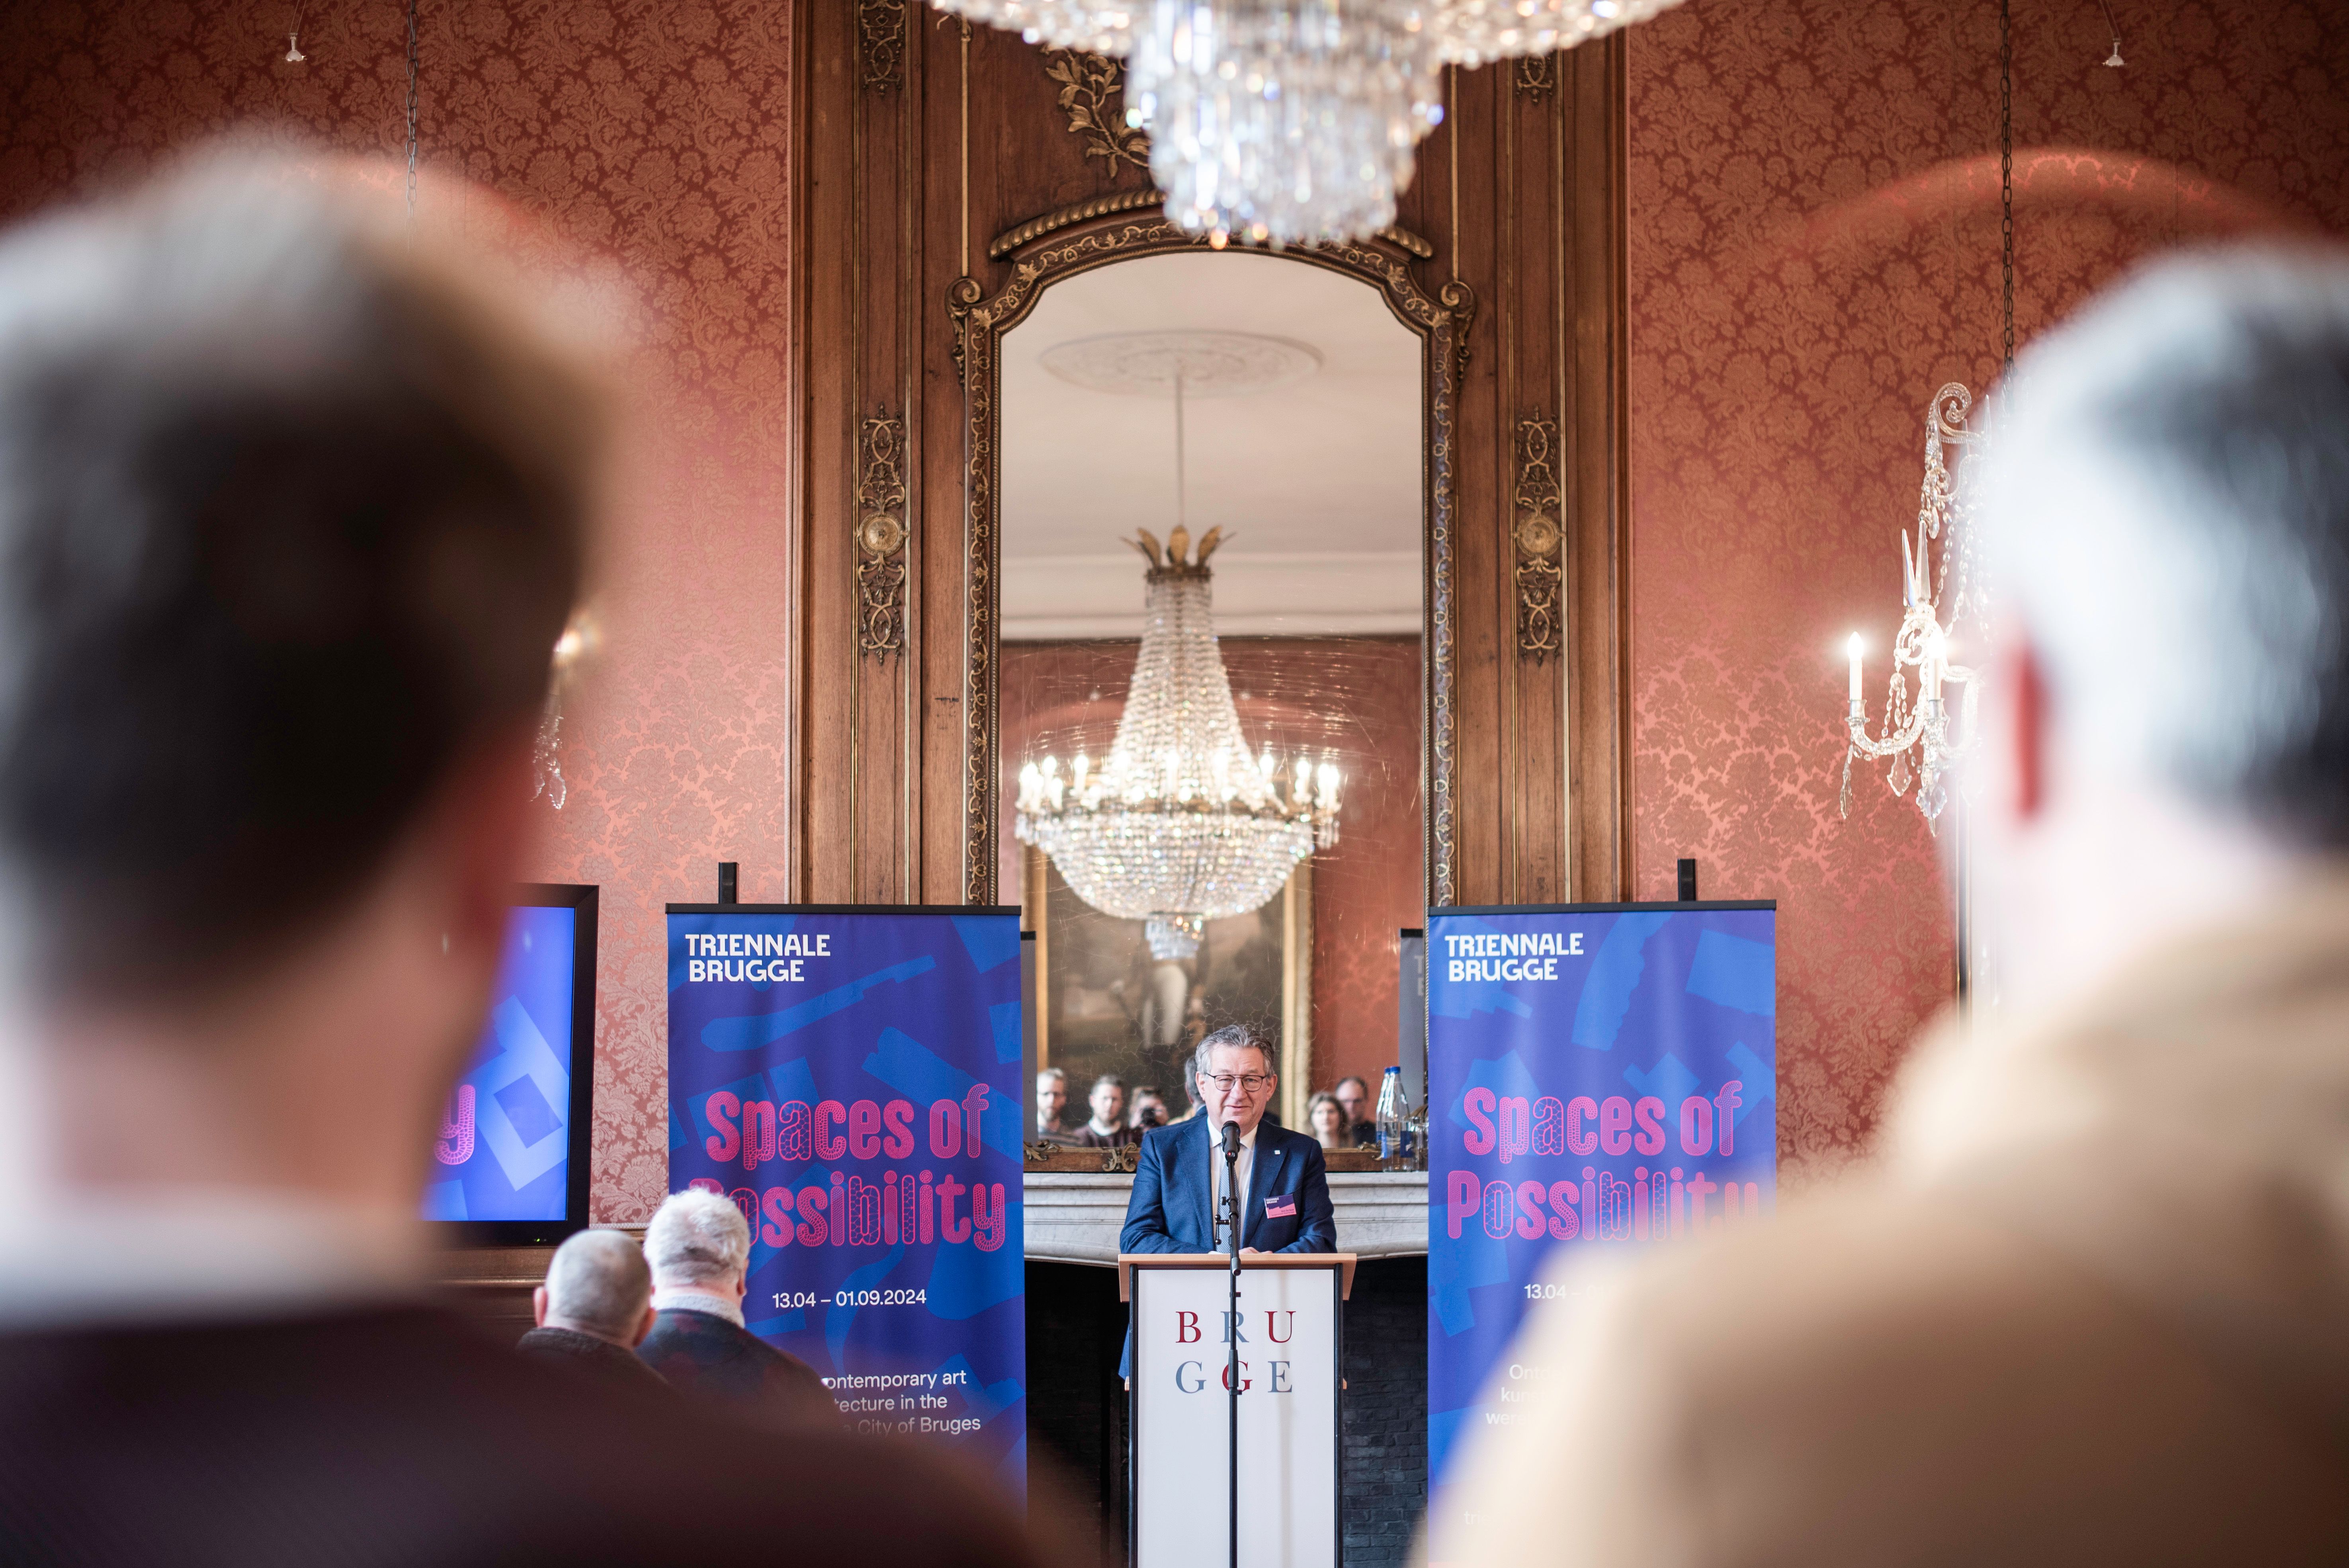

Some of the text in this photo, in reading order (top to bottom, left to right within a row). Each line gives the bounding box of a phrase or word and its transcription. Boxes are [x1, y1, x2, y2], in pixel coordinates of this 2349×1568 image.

[685, 934, 831, 957] TRIENNALE
[1444, 933, 1584, 957] TRIENNALE
[690, 959, 804, 982] BRUGGE
[1448, 958, 1558, 982] BRUGGE
[705, 1083, 990, 1171] Spaces of
[1464, 1080, 1743, 1164] Spaces of
[689, 1170, 1005, 1252] ossibility
[772, 1292, 816, 1308] 13.04
[836, 1289, 927, 1307] 01.09.2024
[1524, 1283, 1567, 1299] 13.04
[827, 1370, 967, 1391] ontemporary art
[835, 1393, 948, 1412] ecture in the
[858, 1418, 893, 1436] City
[897, 1417, 915, 1433] of
[920, 1416, 981, 1435] Bruges
